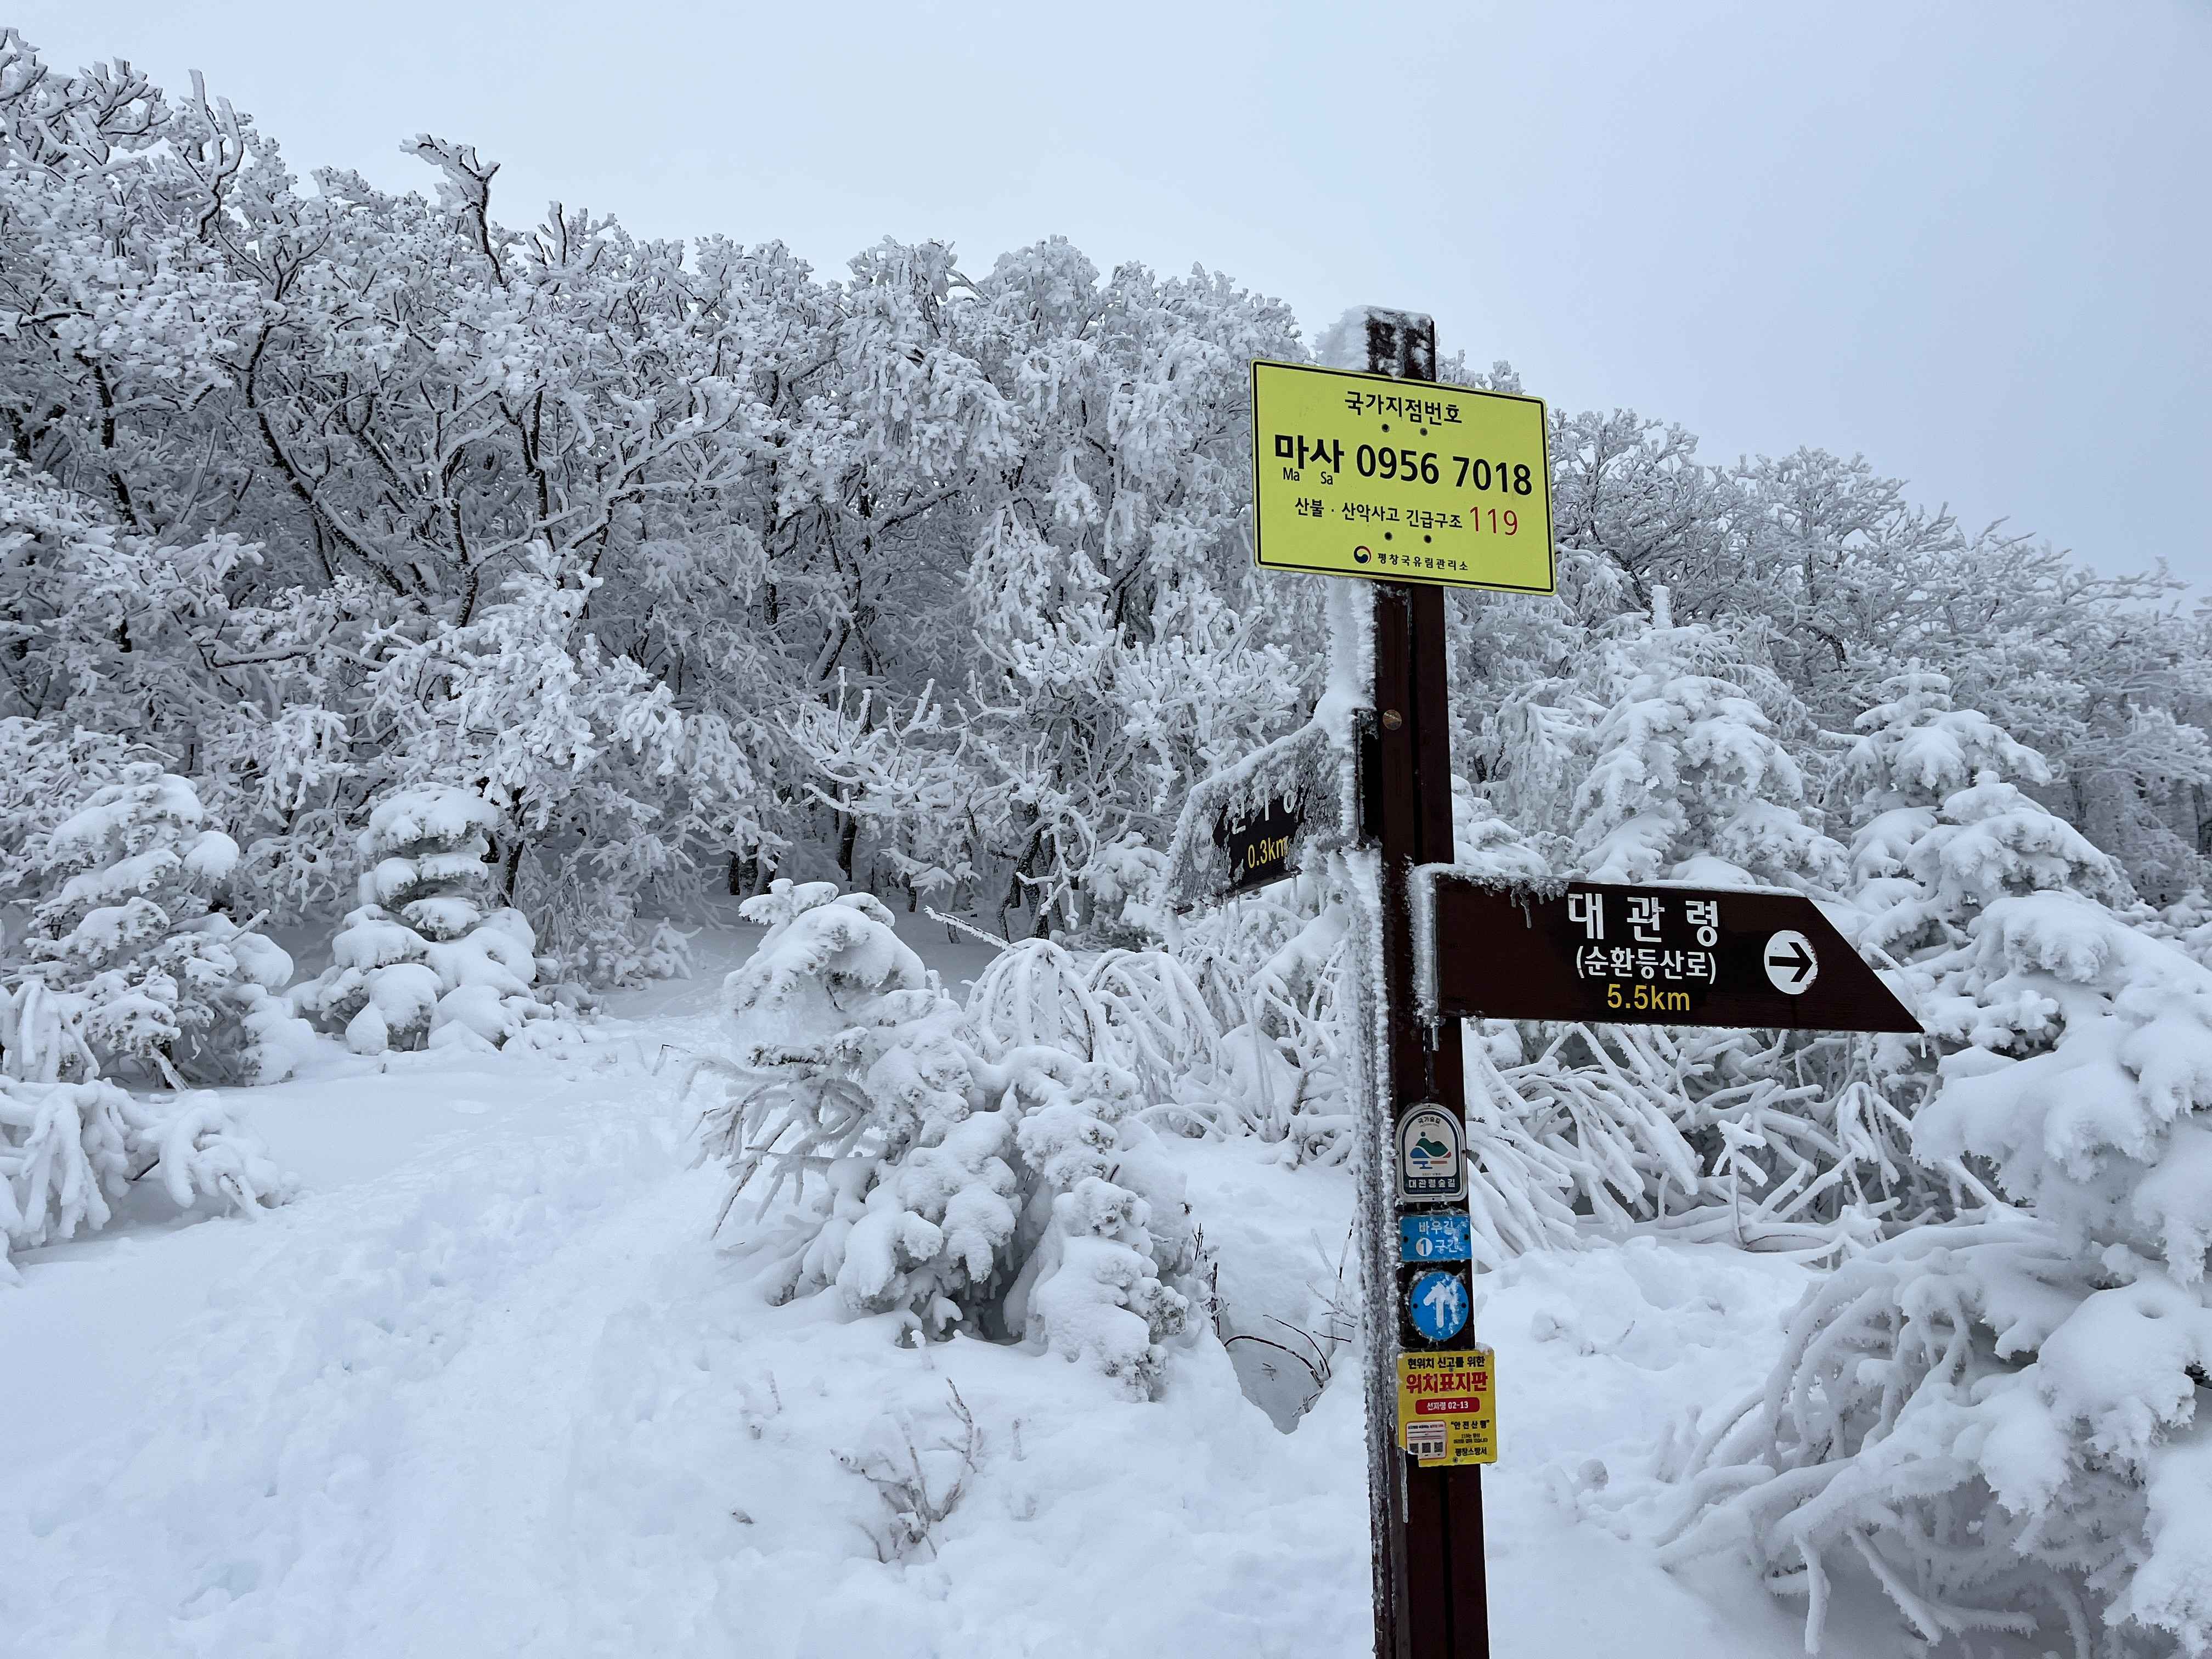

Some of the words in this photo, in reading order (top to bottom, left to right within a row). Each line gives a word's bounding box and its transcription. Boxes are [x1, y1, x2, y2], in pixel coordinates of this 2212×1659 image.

[1344, 391, 1462, 426] 국가지점번호
[1274, 434, 1345, 473] 마사
[1356, 444, 1440, 484] 0956
[1452, 455, 1532, 495] 7018
[1283, 467, 1300, 482] Ma
[1321, 471, 1333, 485] Sa
[1295, 497, 1324, 517] 산불
[1341, 501, 1401, 522] 산악사고
[1406, 508, 1463, 529] 긴급구조
[1469, 506, 1519, 536] 119
[1378, 553, 1468, 571] 평창국유림관리소
[1248, 836, 1289, 868] 0.3km
[1576, 946, 1716, 984] (순환등산로)
[1607, 984, 1690, 1011] 5.5km
[1467, 1356, 1485, 1367] 위한
[1406, 1372, 1488, 1393] 위치표지판
[1448, 1401, 1469, 1409] 02-13
